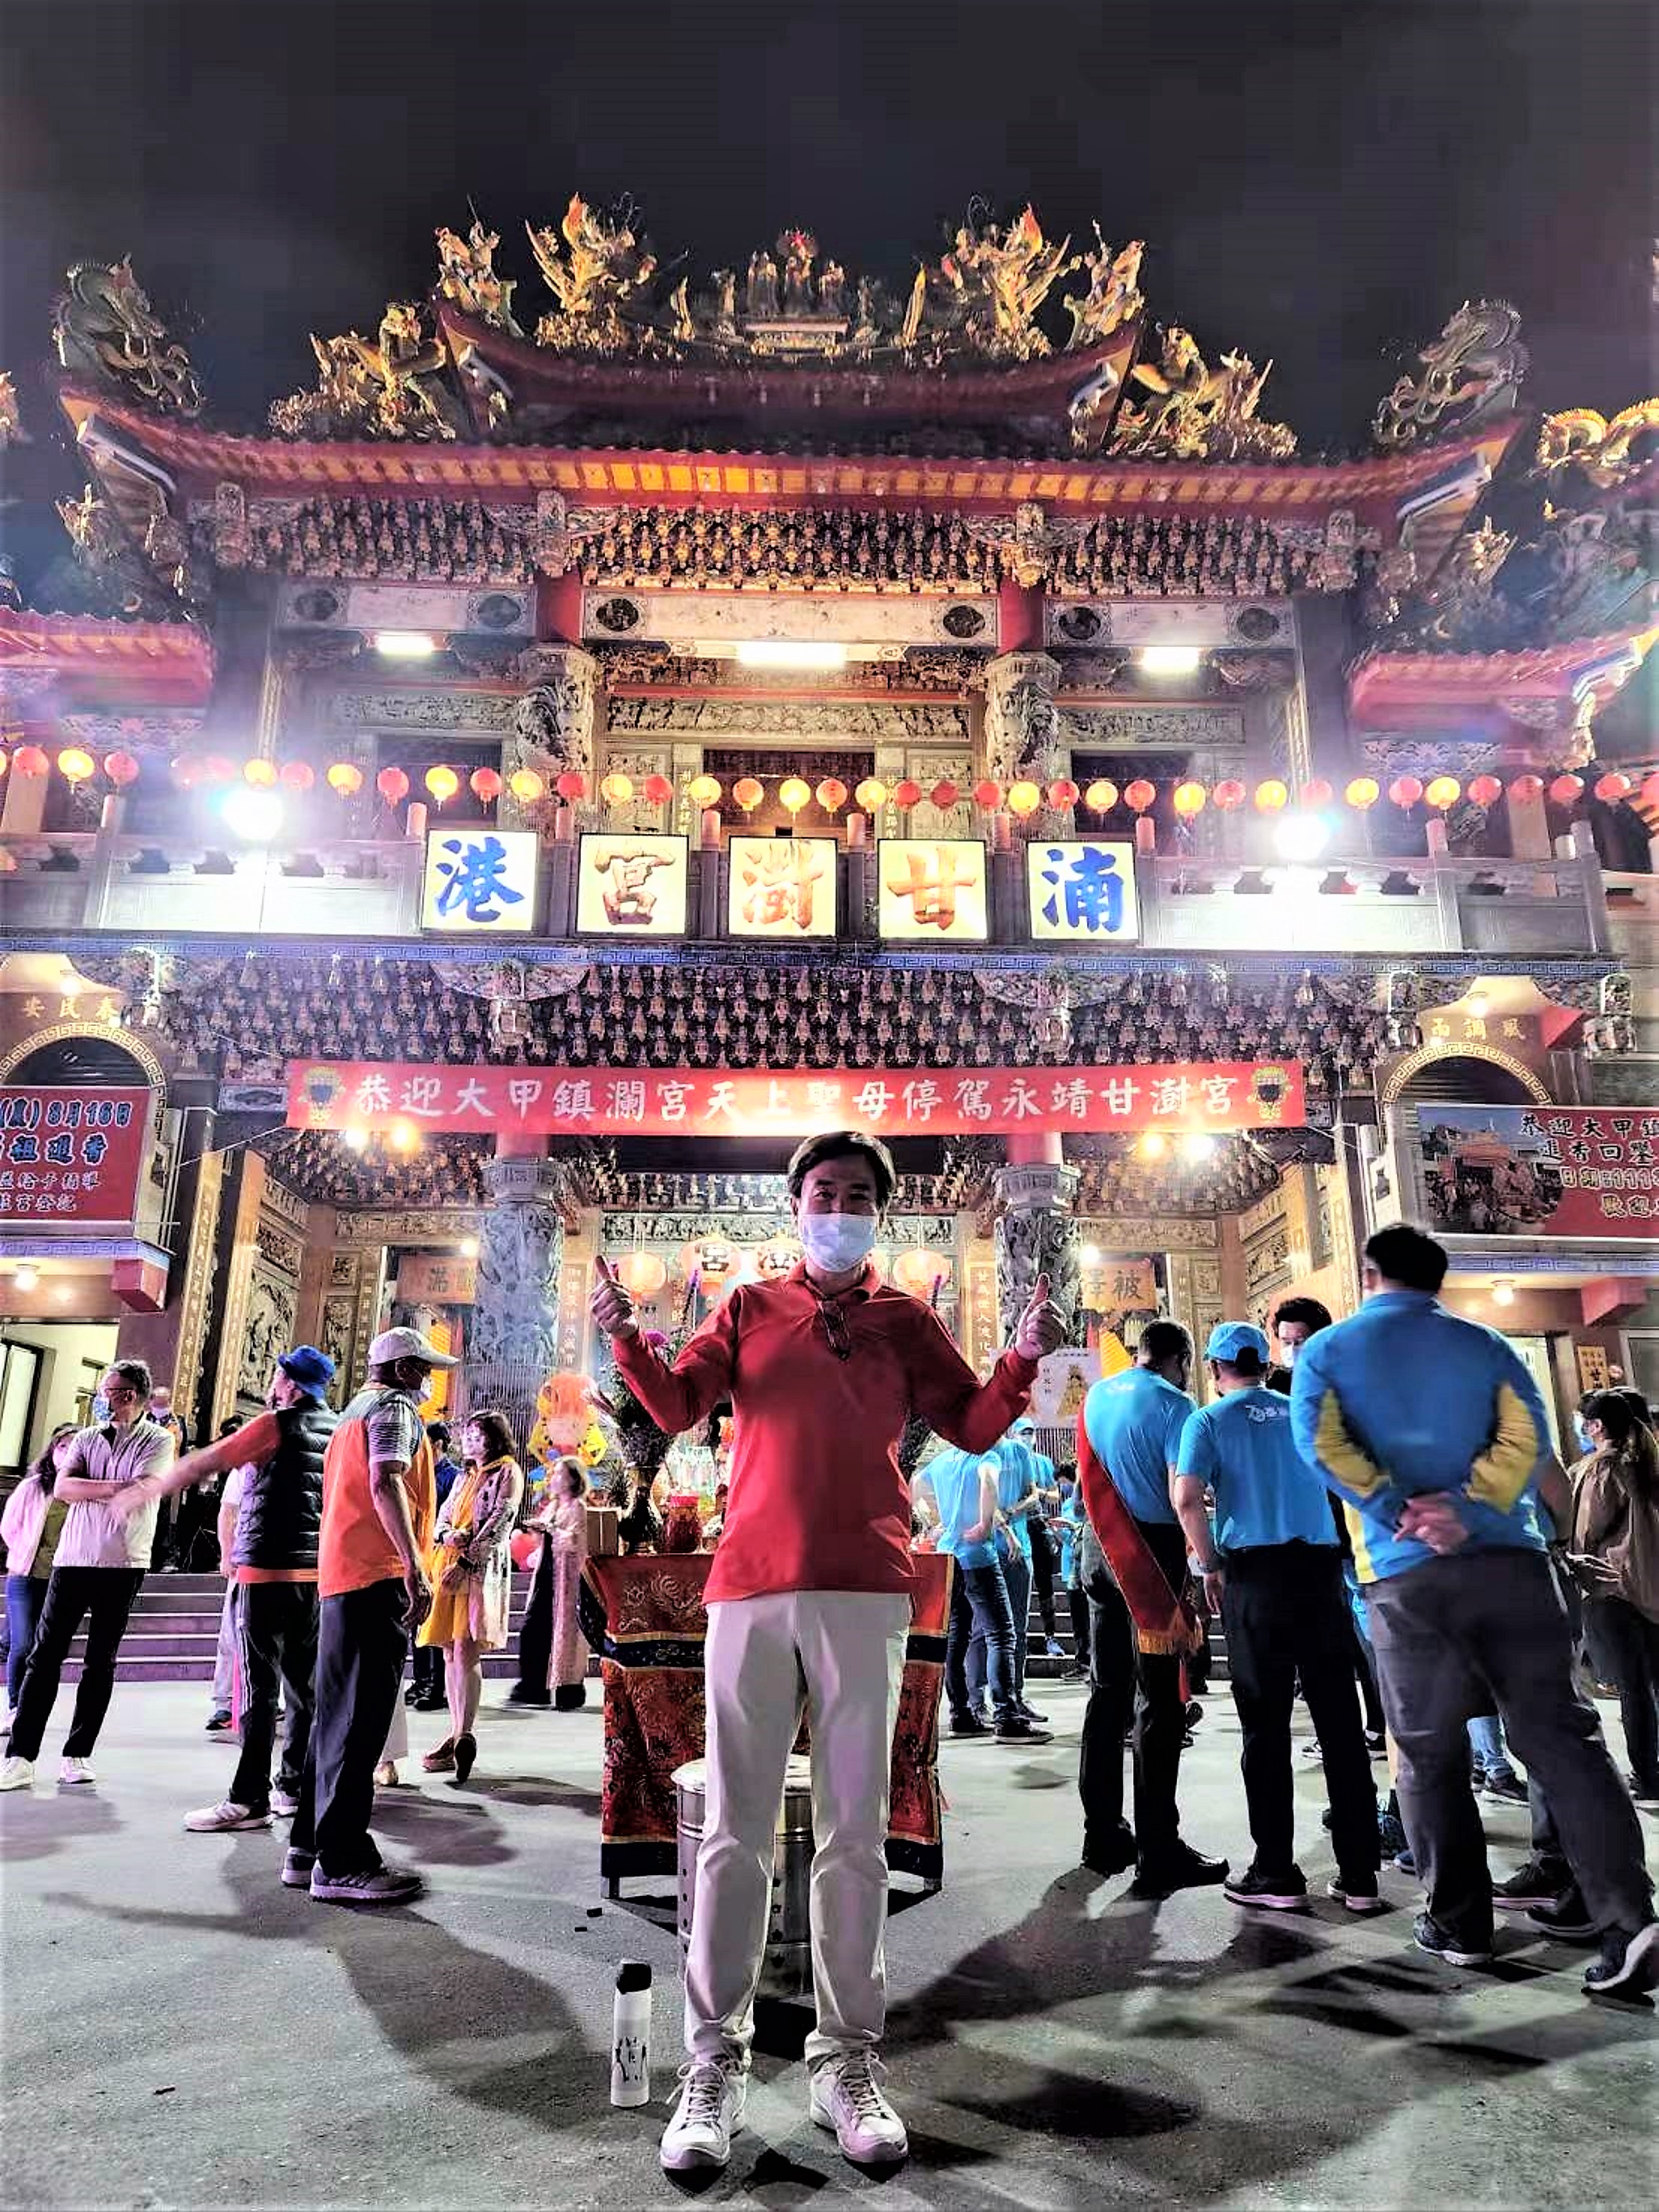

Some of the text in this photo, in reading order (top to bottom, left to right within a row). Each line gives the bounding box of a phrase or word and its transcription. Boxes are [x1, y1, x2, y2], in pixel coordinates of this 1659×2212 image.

[435, 836, 526, 923] 港
[594, 844, 675, 926] 宮
[886, 844, 977, 930] 甘
[355, 1074, 1239, 1122] 恭迎大甲鎮瀾宮天上聖母停駕永靖甘澍宮
[1601, 1193, 1659, 1218] 歡迎
